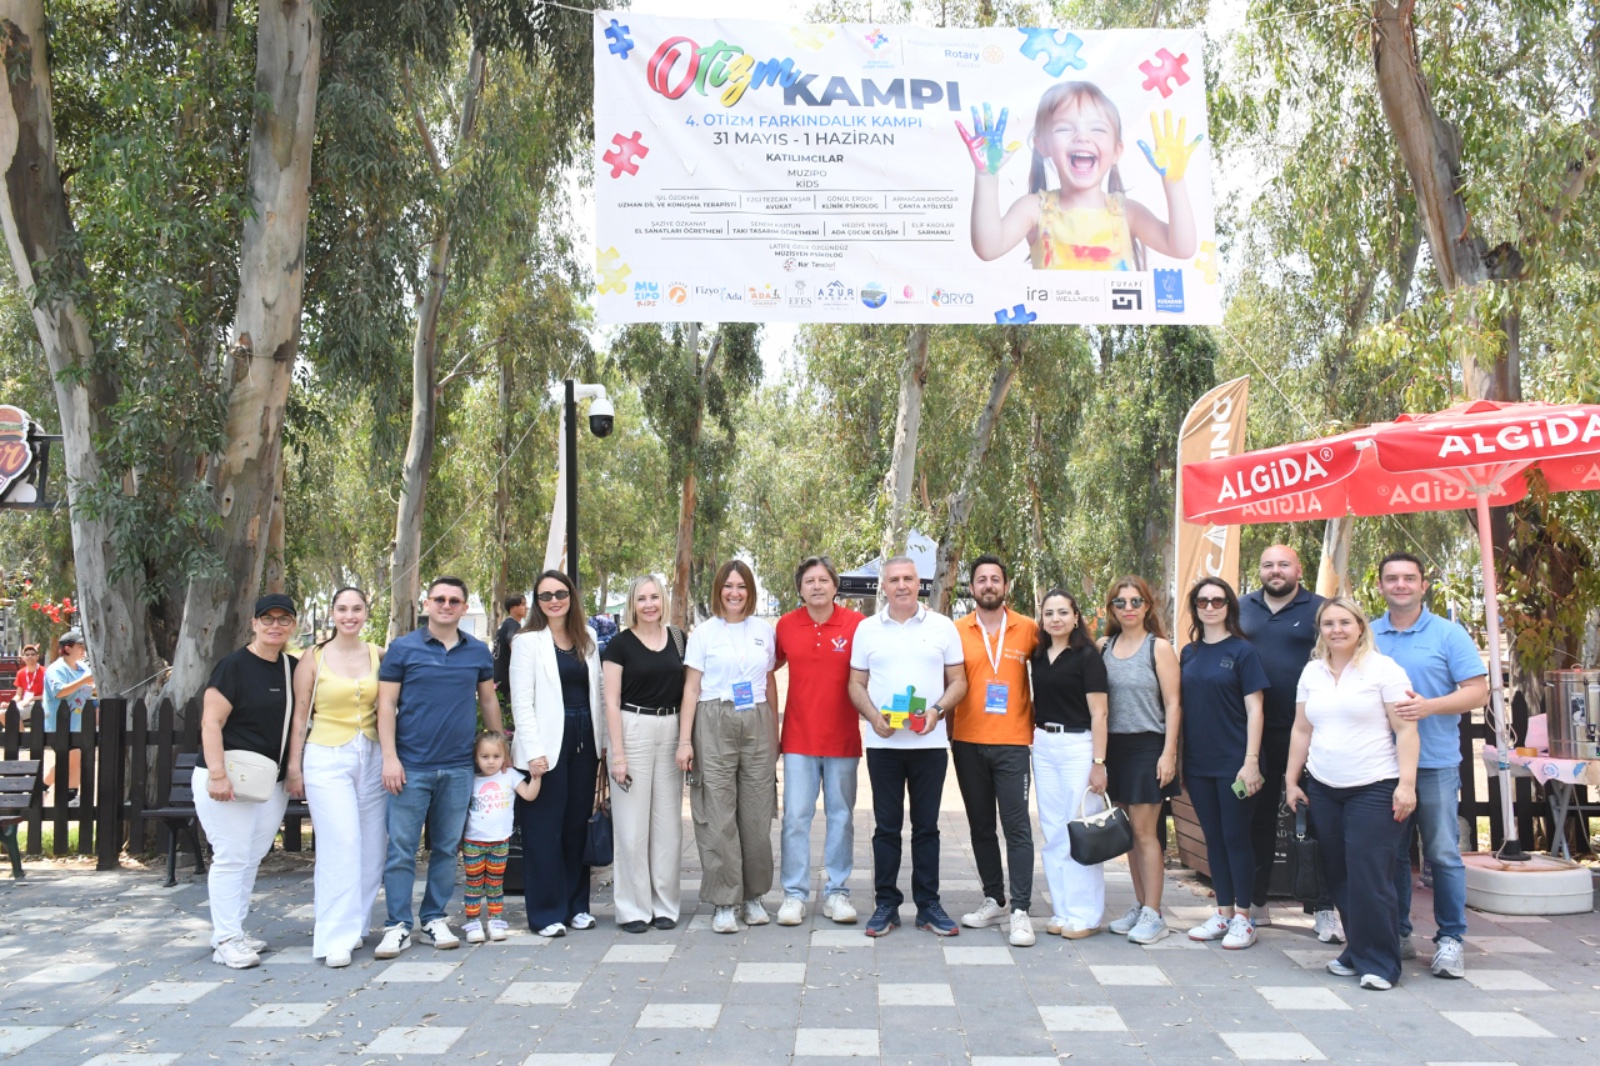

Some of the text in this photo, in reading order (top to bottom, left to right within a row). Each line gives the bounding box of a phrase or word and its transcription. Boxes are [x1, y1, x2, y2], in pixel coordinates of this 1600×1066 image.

[944, 49, 980, 61] Rotary
[646, 36, 801, 108] Otizm
[783, 73, 962, 112] KAMPI
[685, 113, 923, 128] 4. OTİZM FARKINDALIK KAMPI
[713, 131, 729, 145] 31
[734, 132, 788, 145] MAYIS
[803, 132, 810, 145] 1
[816, 129, 895, 145] HAZİRAN
[765, 153, 844, 164] KATILIMCILAR
[667, 202, 701, 210] KONUŞMA
[765, 202, 792, 210] AVUKAT
[844, 202, 879, 210] PSİKOLOG
[634, 281, 658, 291] MU
[695, 285, 720, 296] Fizyo
[725, 292, 742, 301] Ada
[817, 288, 854, 297] AZUR
[1026, 286, 1049, 301] ira
[788, 297, 812, 305] EFES
